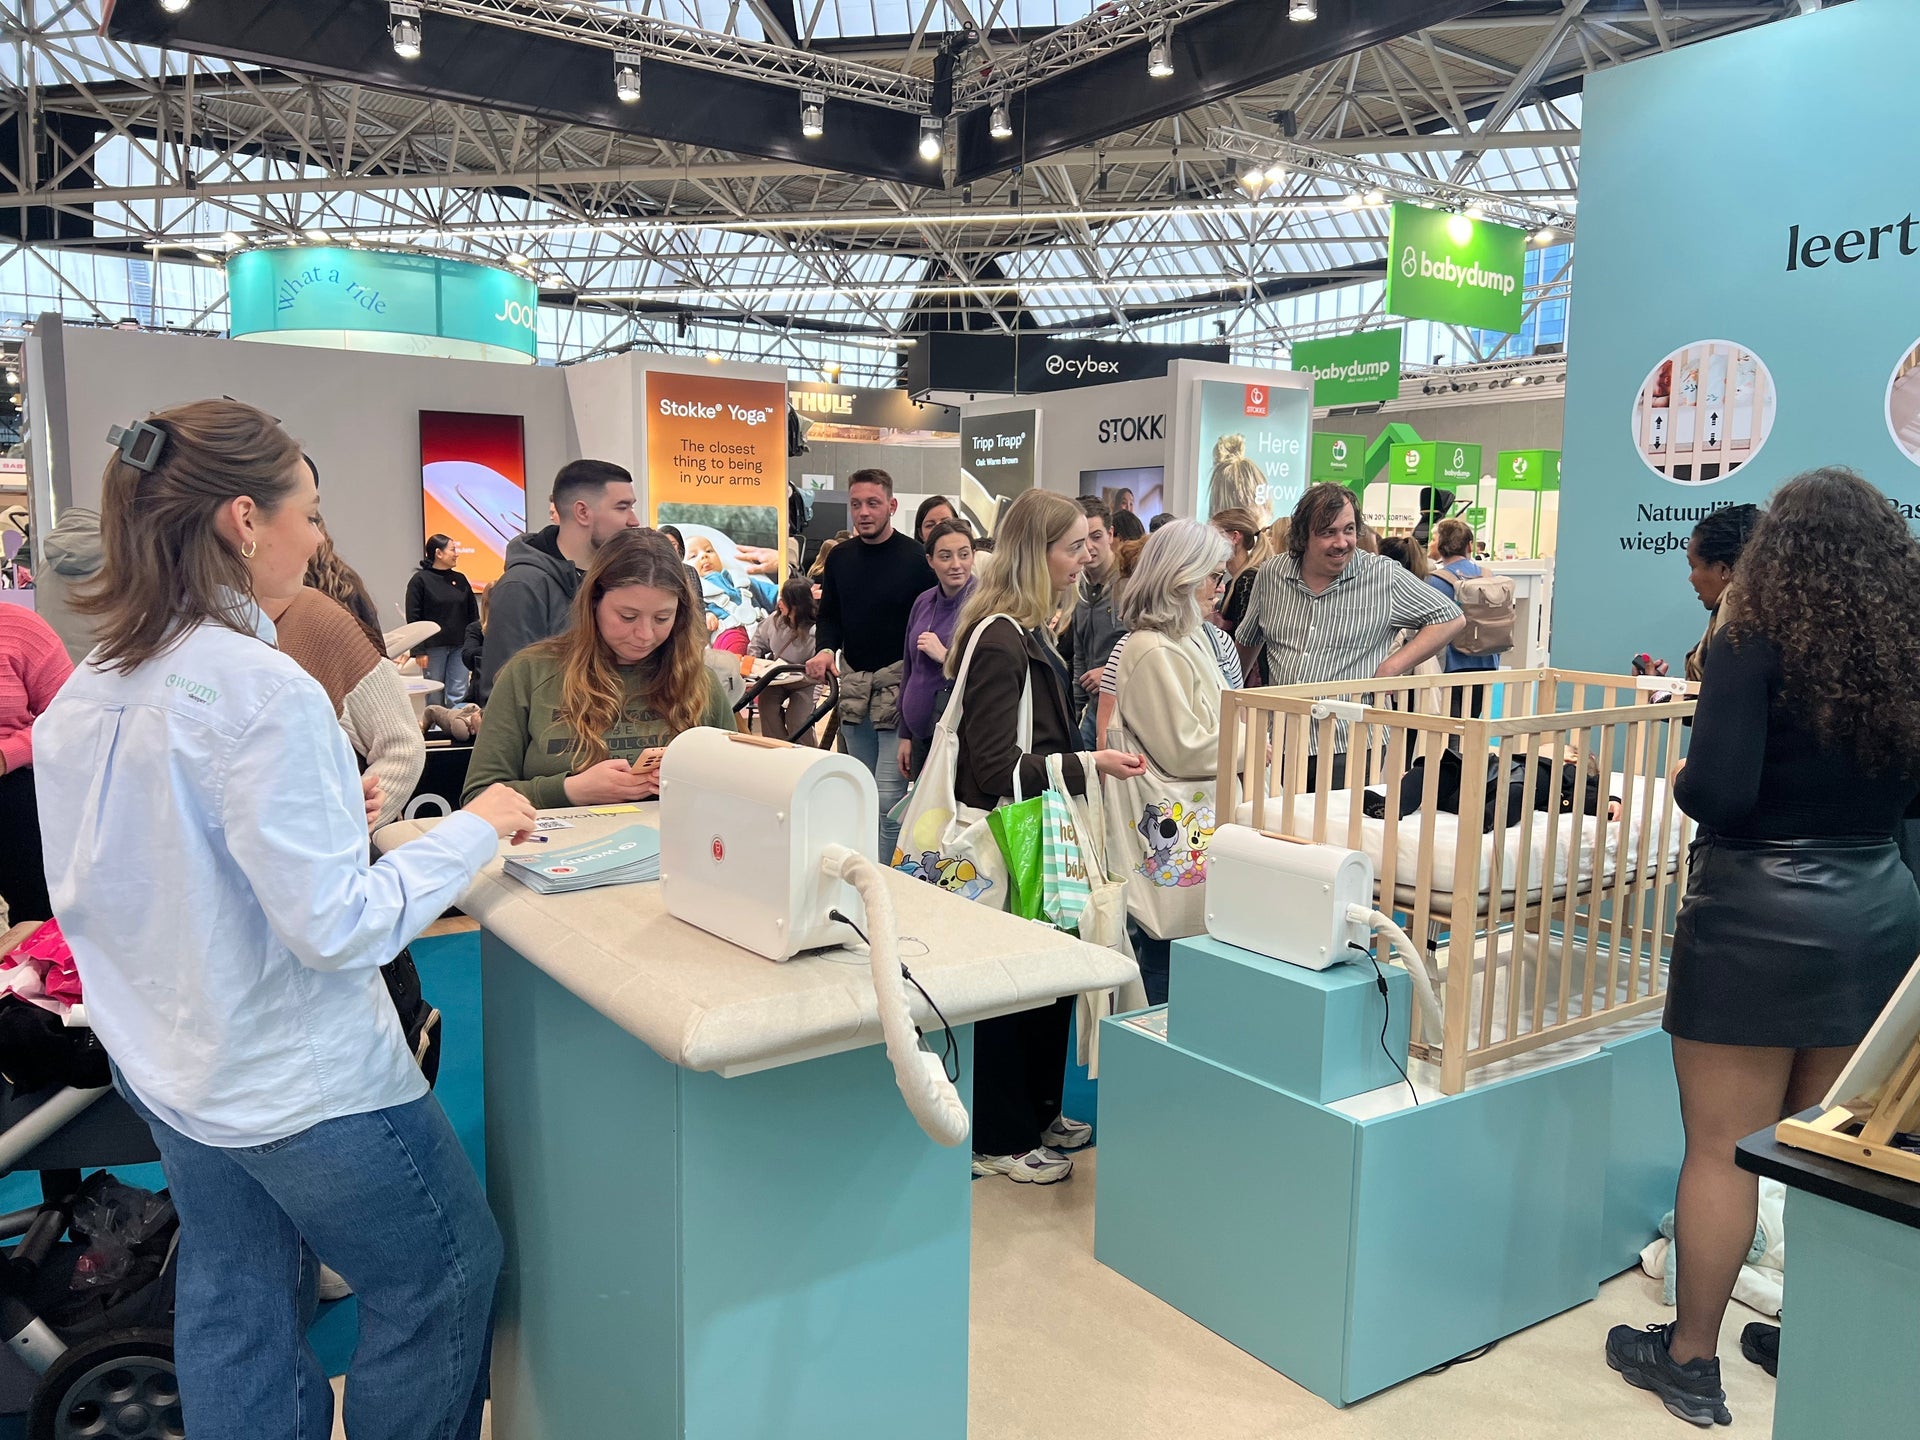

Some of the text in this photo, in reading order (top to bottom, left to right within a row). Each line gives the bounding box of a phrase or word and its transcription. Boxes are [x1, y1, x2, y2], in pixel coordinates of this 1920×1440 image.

[1786, 212, 1919, 271] leert
[1420, 251, 1515, 296] babydump
[277, 267, 386, 314] What a ride
[1065, 354, 1119, 379] cybex
[1312, 360, 1390, 380] babydump
[788, 391, 852, 415] THULE
[1098, 414, 1166, 444] STOKK
[681, 439, 755, 456] The closest
[972, 437, 994, 452] Tripp
[1258, 432, 1299, 455] Here
[673, 455, 763, 474] thing to being
[1265, 461, 1289, 477] we
[680, 471, 761, 487] in your arms
[1254, 482, 1299, 505] grow
[1637, 501, 1734, 522] Natuurl
